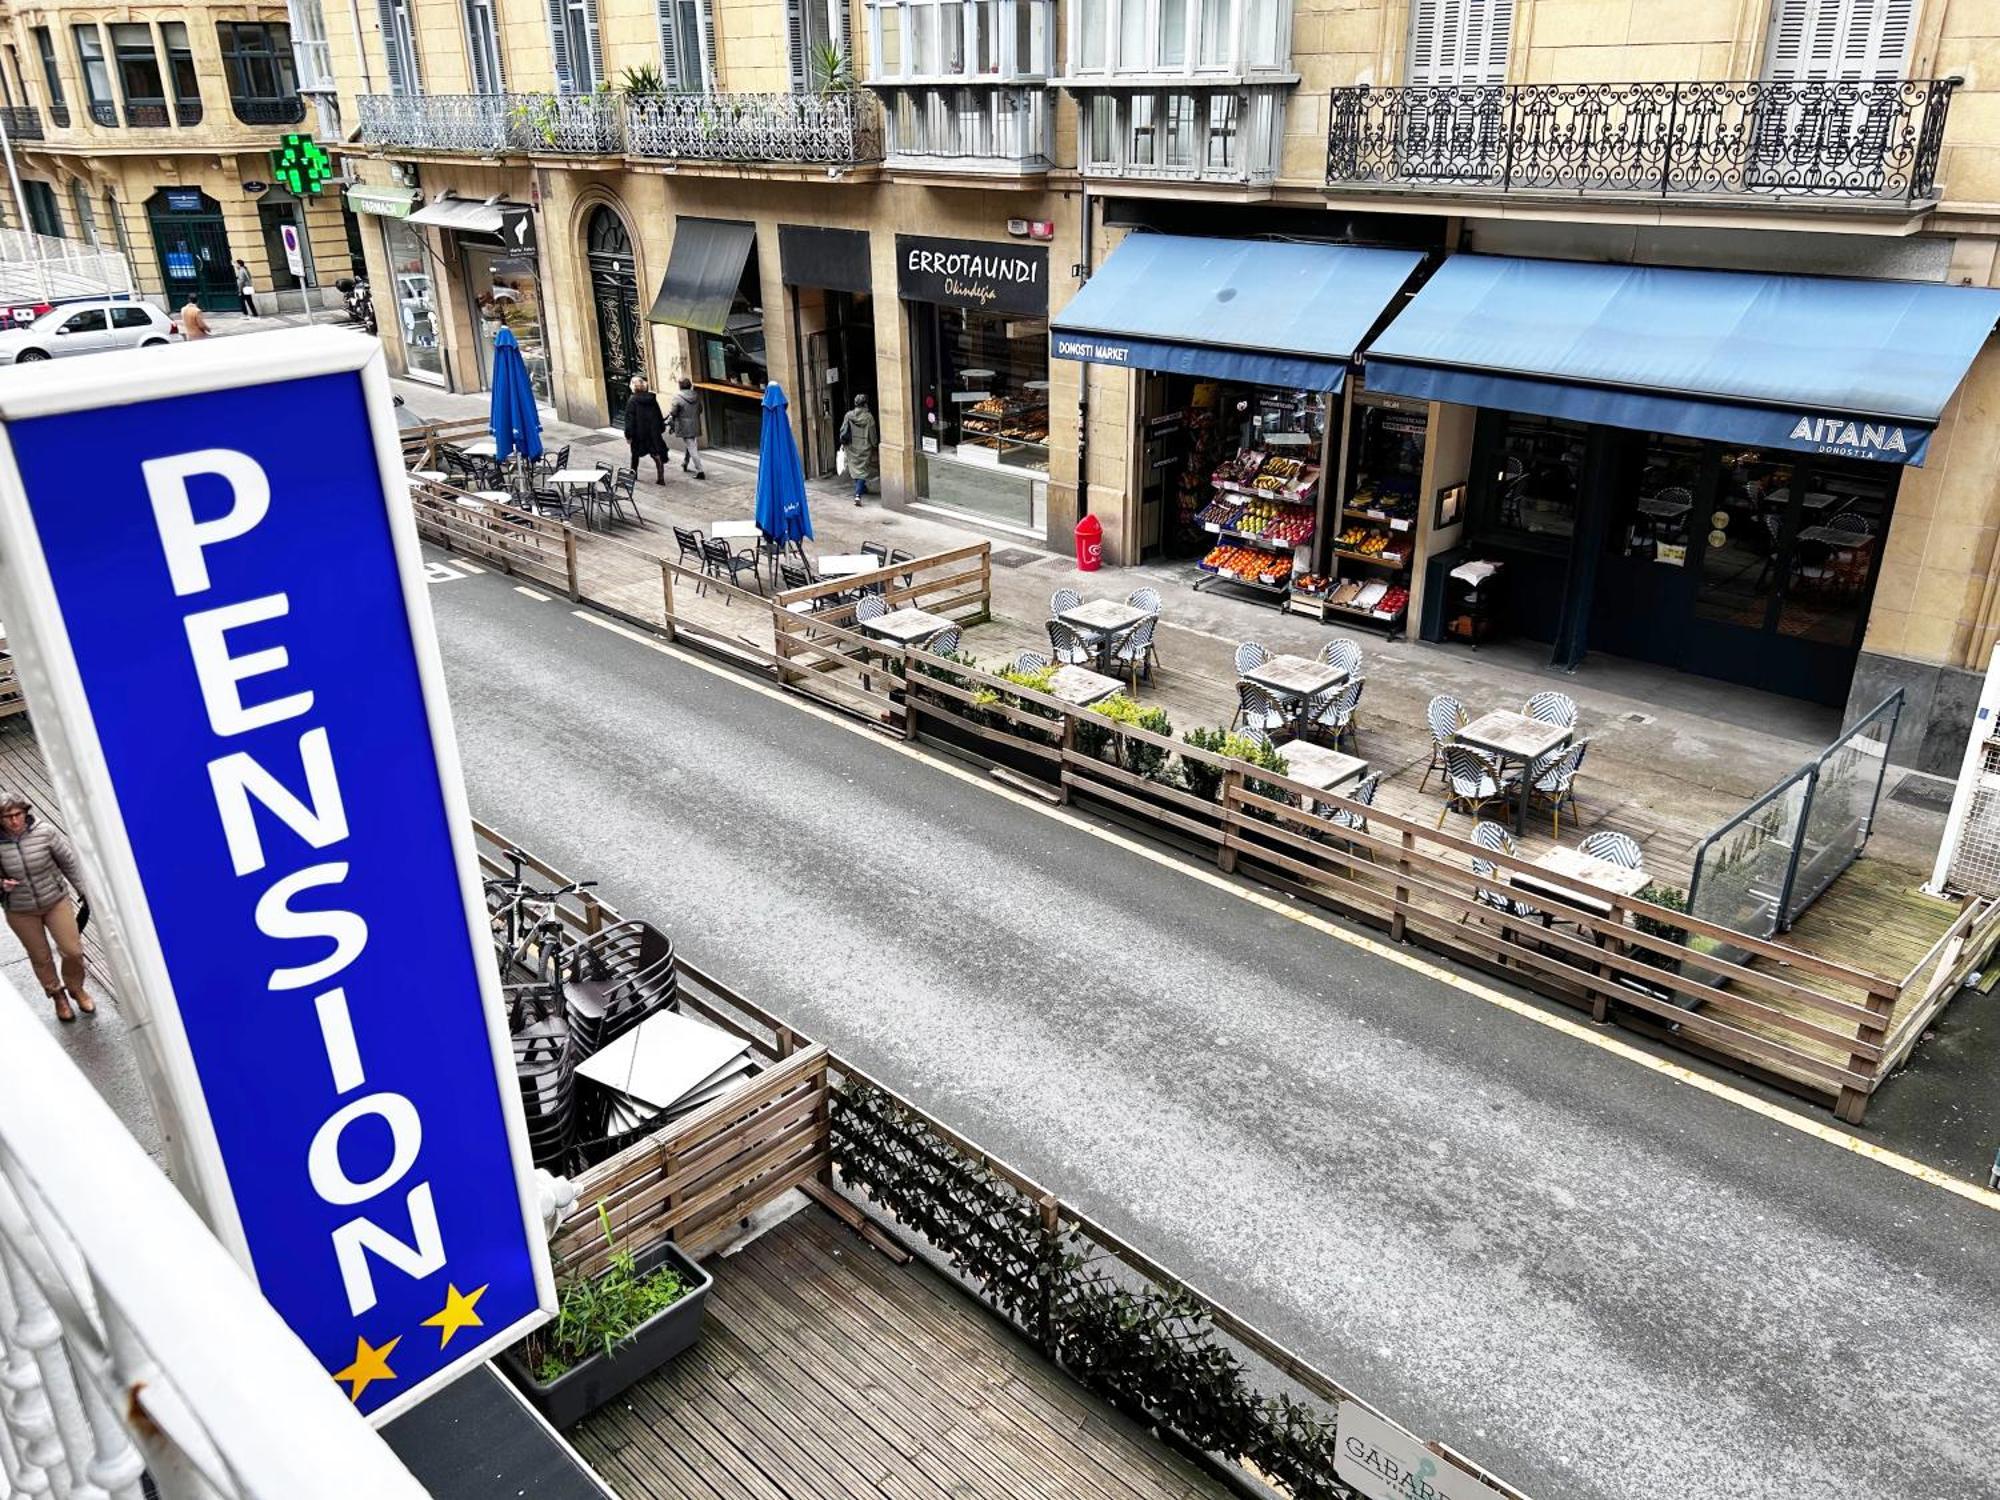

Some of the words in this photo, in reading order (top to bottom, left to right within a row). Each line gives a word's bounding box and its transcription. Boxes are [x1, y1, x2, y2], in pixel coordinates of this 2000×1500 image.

[908, 250, 1038, 283] ERROTAUNDI
[944, 278, 997, 305] Okindegia
[1058, 342, 1093, 357] DONOSTI
[1095, 345, 1129, 361] MARKET
[1790, 416, 1907, 453] AITANA
[1818, 445, 1873, 460] DONOSTIA
[140, 447, 448, 1318] PENSION
